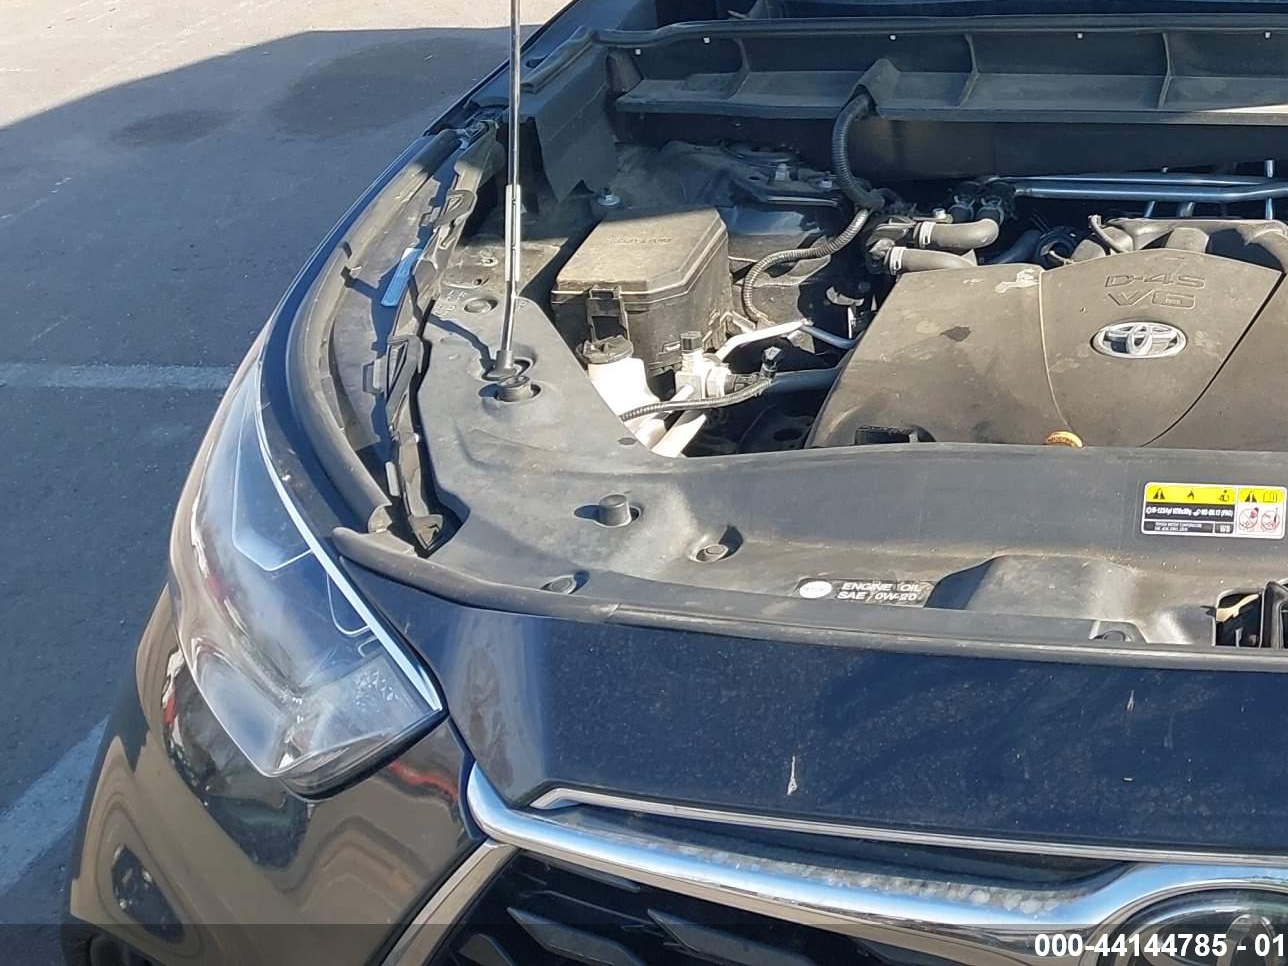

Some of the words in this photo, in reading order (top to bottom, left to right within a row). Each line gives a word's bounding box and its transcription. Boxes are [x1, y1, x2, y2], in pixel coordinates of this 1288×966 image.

[1105, 274, 1205, 289] D-4S
[1108, 289, 1195, 309] V6
[841, 582, 893, 592] ENGINE
[900, 583, 922, 592] OIL
[837, 591, 867, 600] SAE
[874, 592, 918, 601] 0W-20
